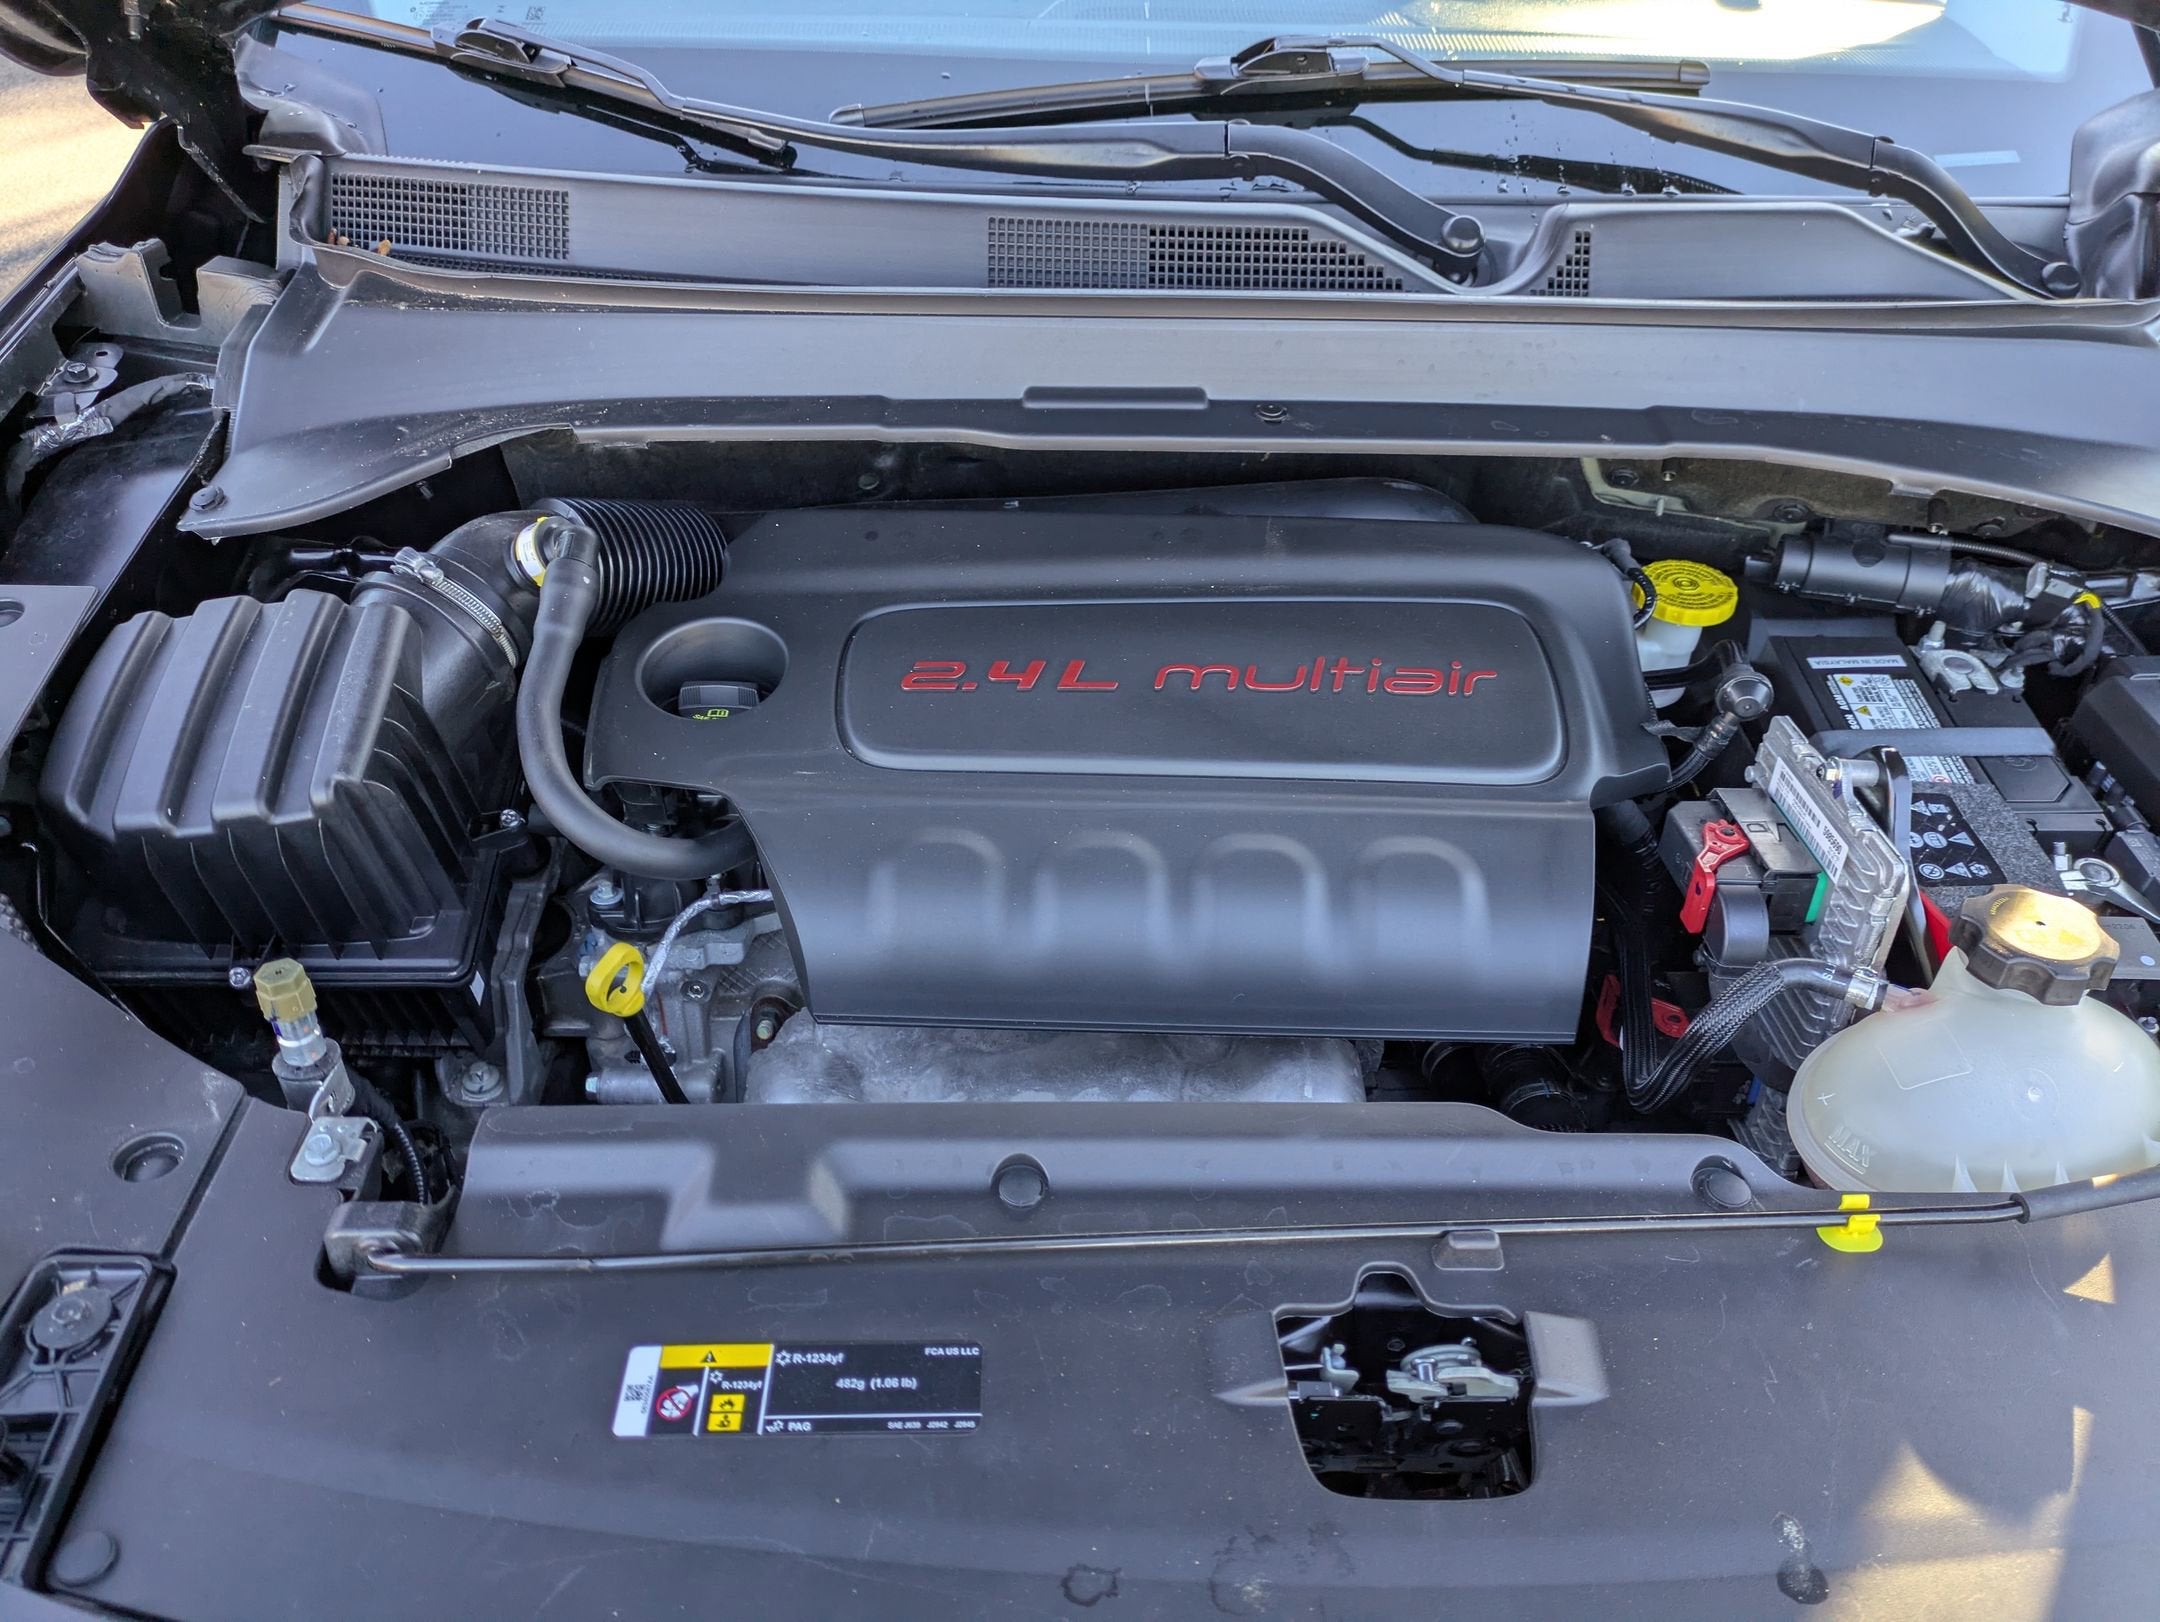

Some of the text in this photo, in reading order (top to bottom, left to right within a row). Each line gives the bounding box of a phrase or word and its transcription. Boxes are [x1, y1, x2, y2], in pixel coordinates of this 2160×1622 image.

[1154, 656, 1498, 697] multiair
[1827, 1125, 1875, 1168] MAX
[924, 1347, 979, 1357] FCA US LLC
[792, 1353, 844, 1365] R-1234yf
[721, 1380, 763, 1391] R-1234yf
[836, 1377, 917, 1391] 482g (1.06 lb)
[788, 1421, 812, 1432] PAG
